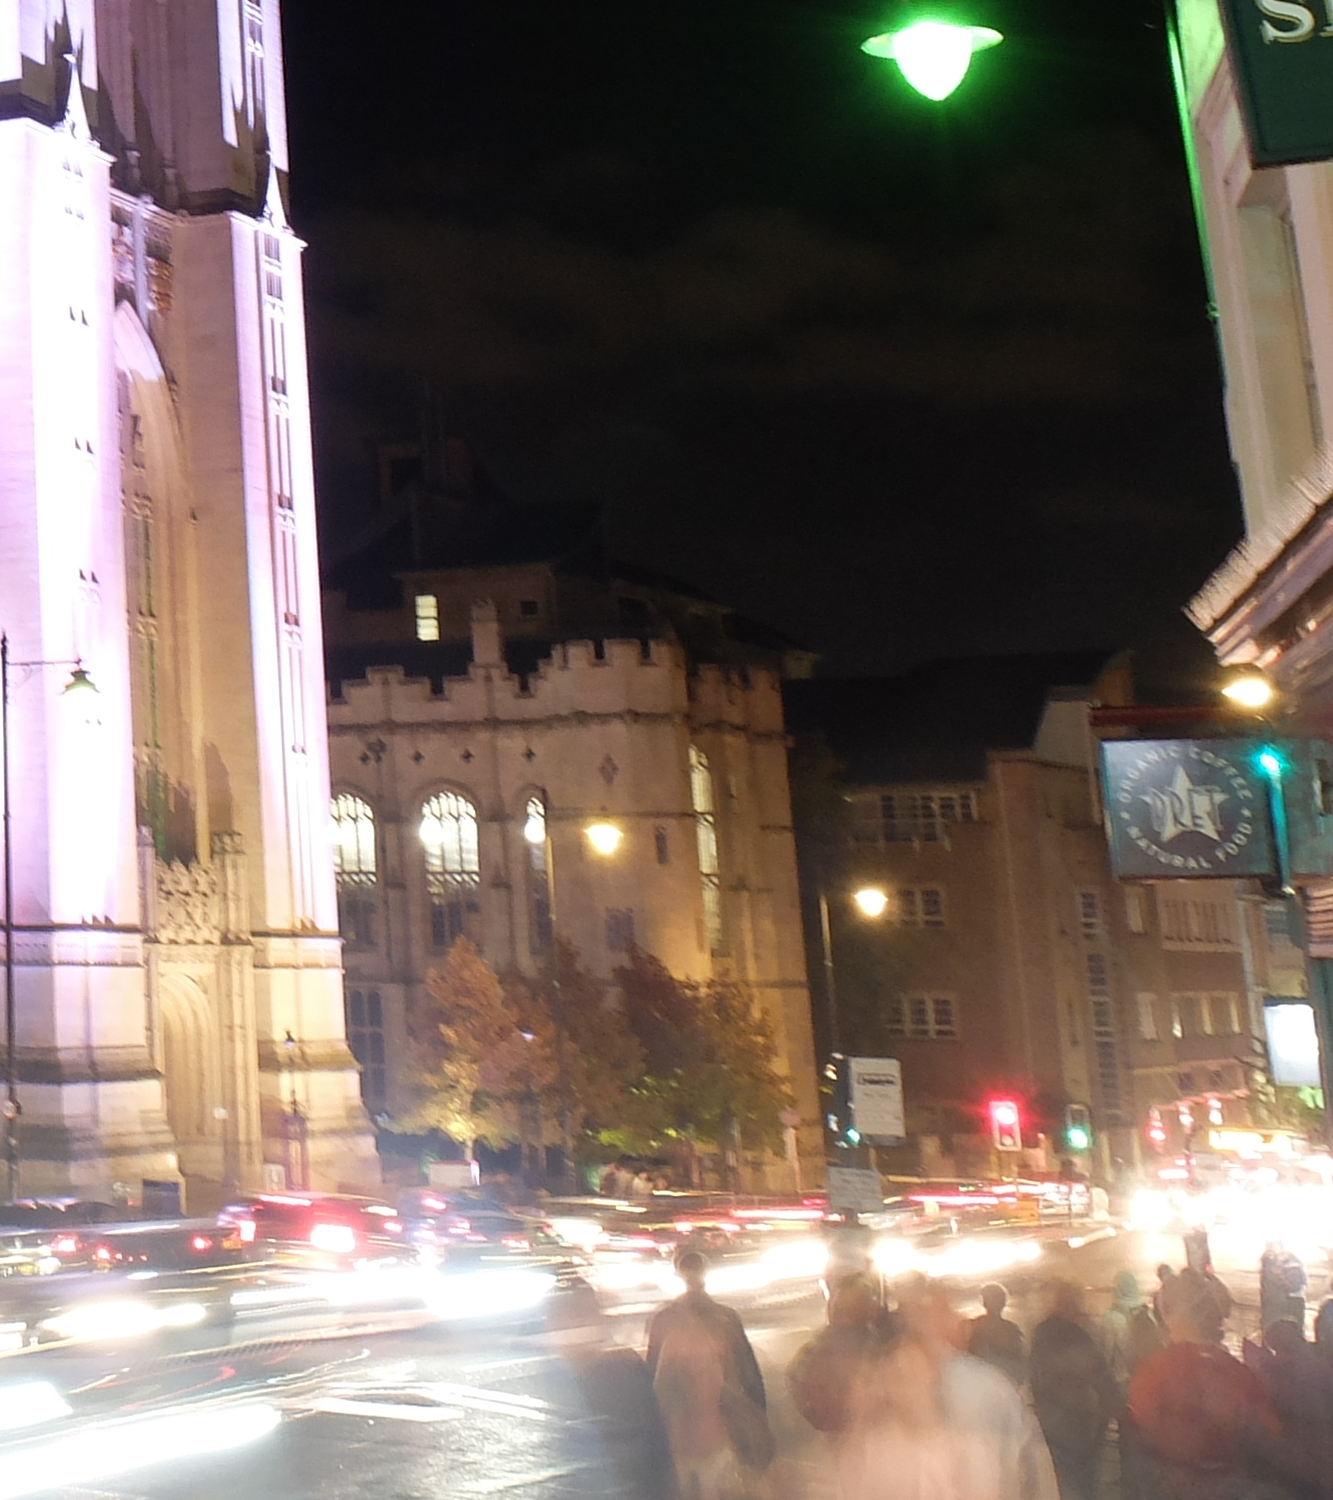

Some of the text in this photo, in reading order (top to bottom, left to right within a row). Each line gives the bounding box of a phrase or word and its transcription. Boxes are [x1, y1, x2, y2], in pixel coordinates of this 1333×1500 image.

[1117, 745, 1253, 803] ORGANIC COFFEE
[1147, 784, 1225, 832] PRET
[1127, 822, 1253, 869] NATURAL FOOD
